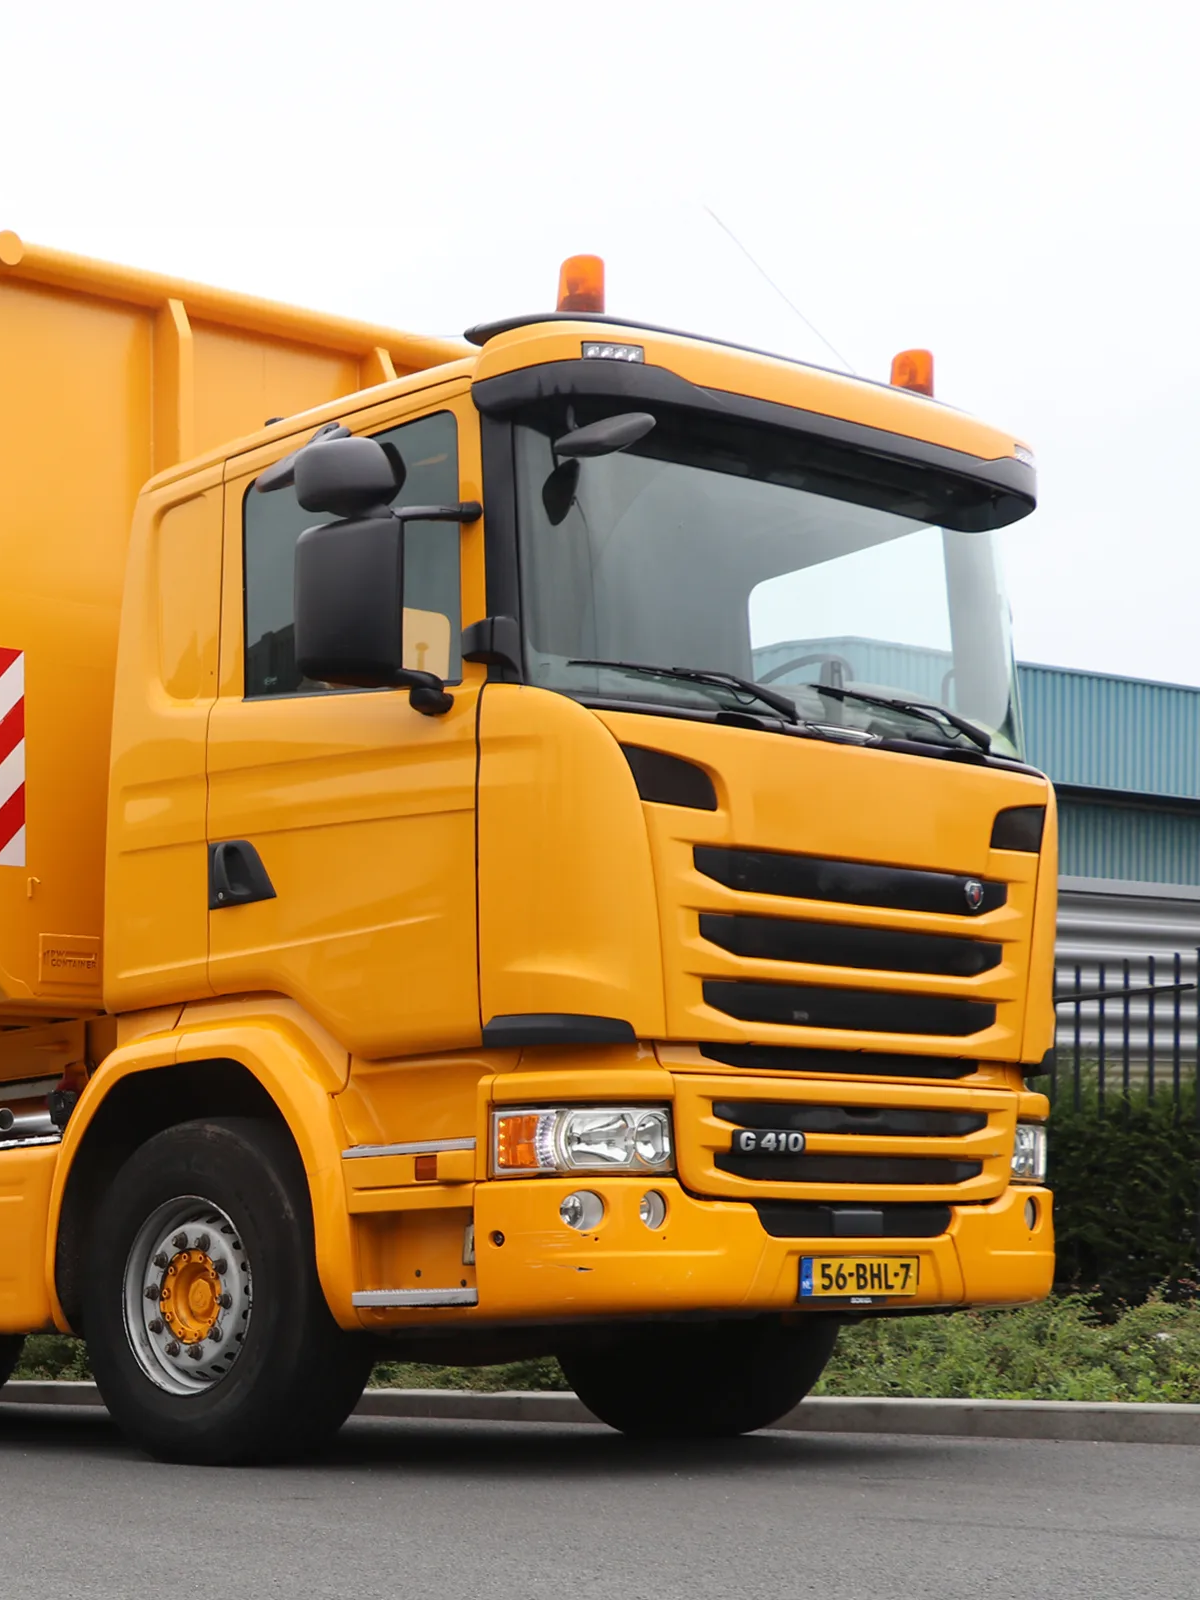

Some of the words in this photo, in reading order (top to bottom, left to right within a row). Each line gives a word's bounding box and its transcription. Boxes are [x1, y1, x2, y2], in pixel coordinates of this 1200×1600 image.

[50, 958, 97, 969] CONTAINER
[740, 1131, 756, 1151] G
[760, 1132, 804, 1152] 410
[821, 1263, 911, 1290] 56-BHL-7
[802, 1280, 812, 1290] NL
